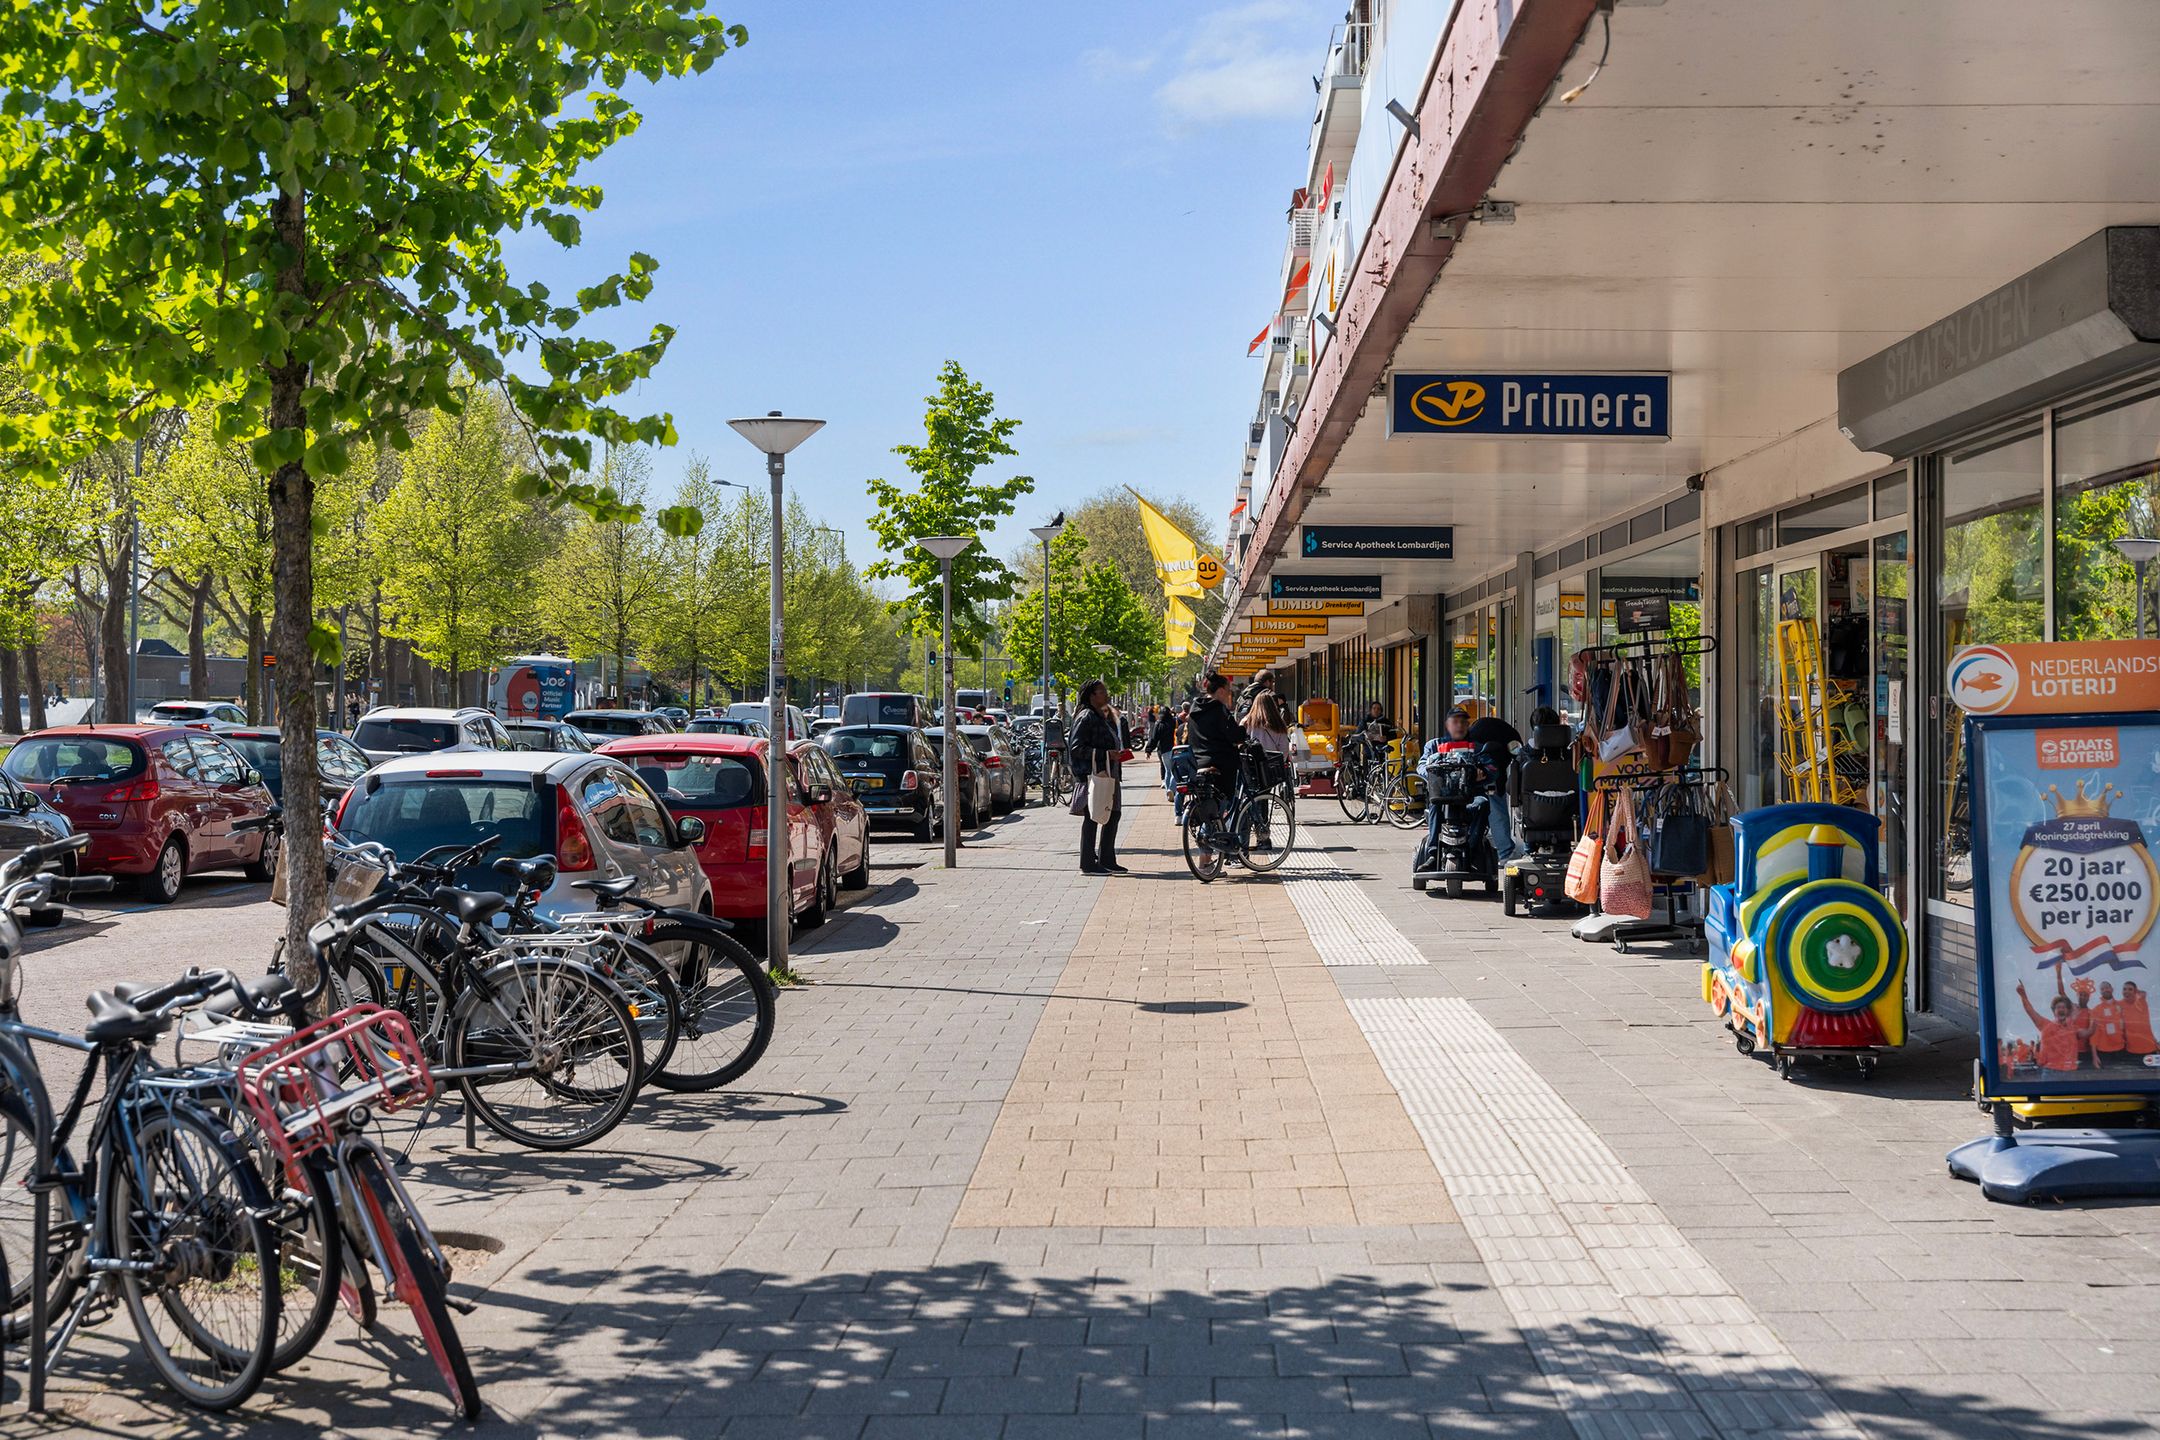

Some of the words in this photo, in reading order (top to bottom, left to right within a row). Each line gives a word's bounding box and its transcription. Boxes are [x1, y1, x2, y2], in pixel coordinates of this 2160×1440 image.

[1884, 278, 2031, 401] STAATSLOTEN
[1502, 381, 1652, 428] Primera
[1321, 540, 1353, 550] Service
[1355, 541, 1396, 551] Apotheek
[1397, 541, 1450, 551] Lombardijen
[1309, 585, 1339, 593] Apotheek
[1340, 585, 1380, 593] Lombardijen
[1272, 599, 1324, 611] JUMBO
[1255, 620, 1296, 630] JUMBO
[1243, 636, 1278, 645] JUMBO
[2030, 656, 2160, 676] NEDERLANDS
[2031, 677, 2116, 697] LOTERIJ
[2060, 738, 2113, 751] STAATS
[2060, 750, 2114, 763] LOTERIJ
[2063, 822, 2075, 831] 27
[2077, 822, 2100, 833] april
[2035, 830, 2129, 843] Koningsdagtrekking
[2044, 857, 2073, 876] 20
[2079, 857, 2126, 879] jaar
[2029, 882, 2142, 903] €250.000
[2041, 909, 2081, 930] per
[2085, 905, 2134, 928] jaar
